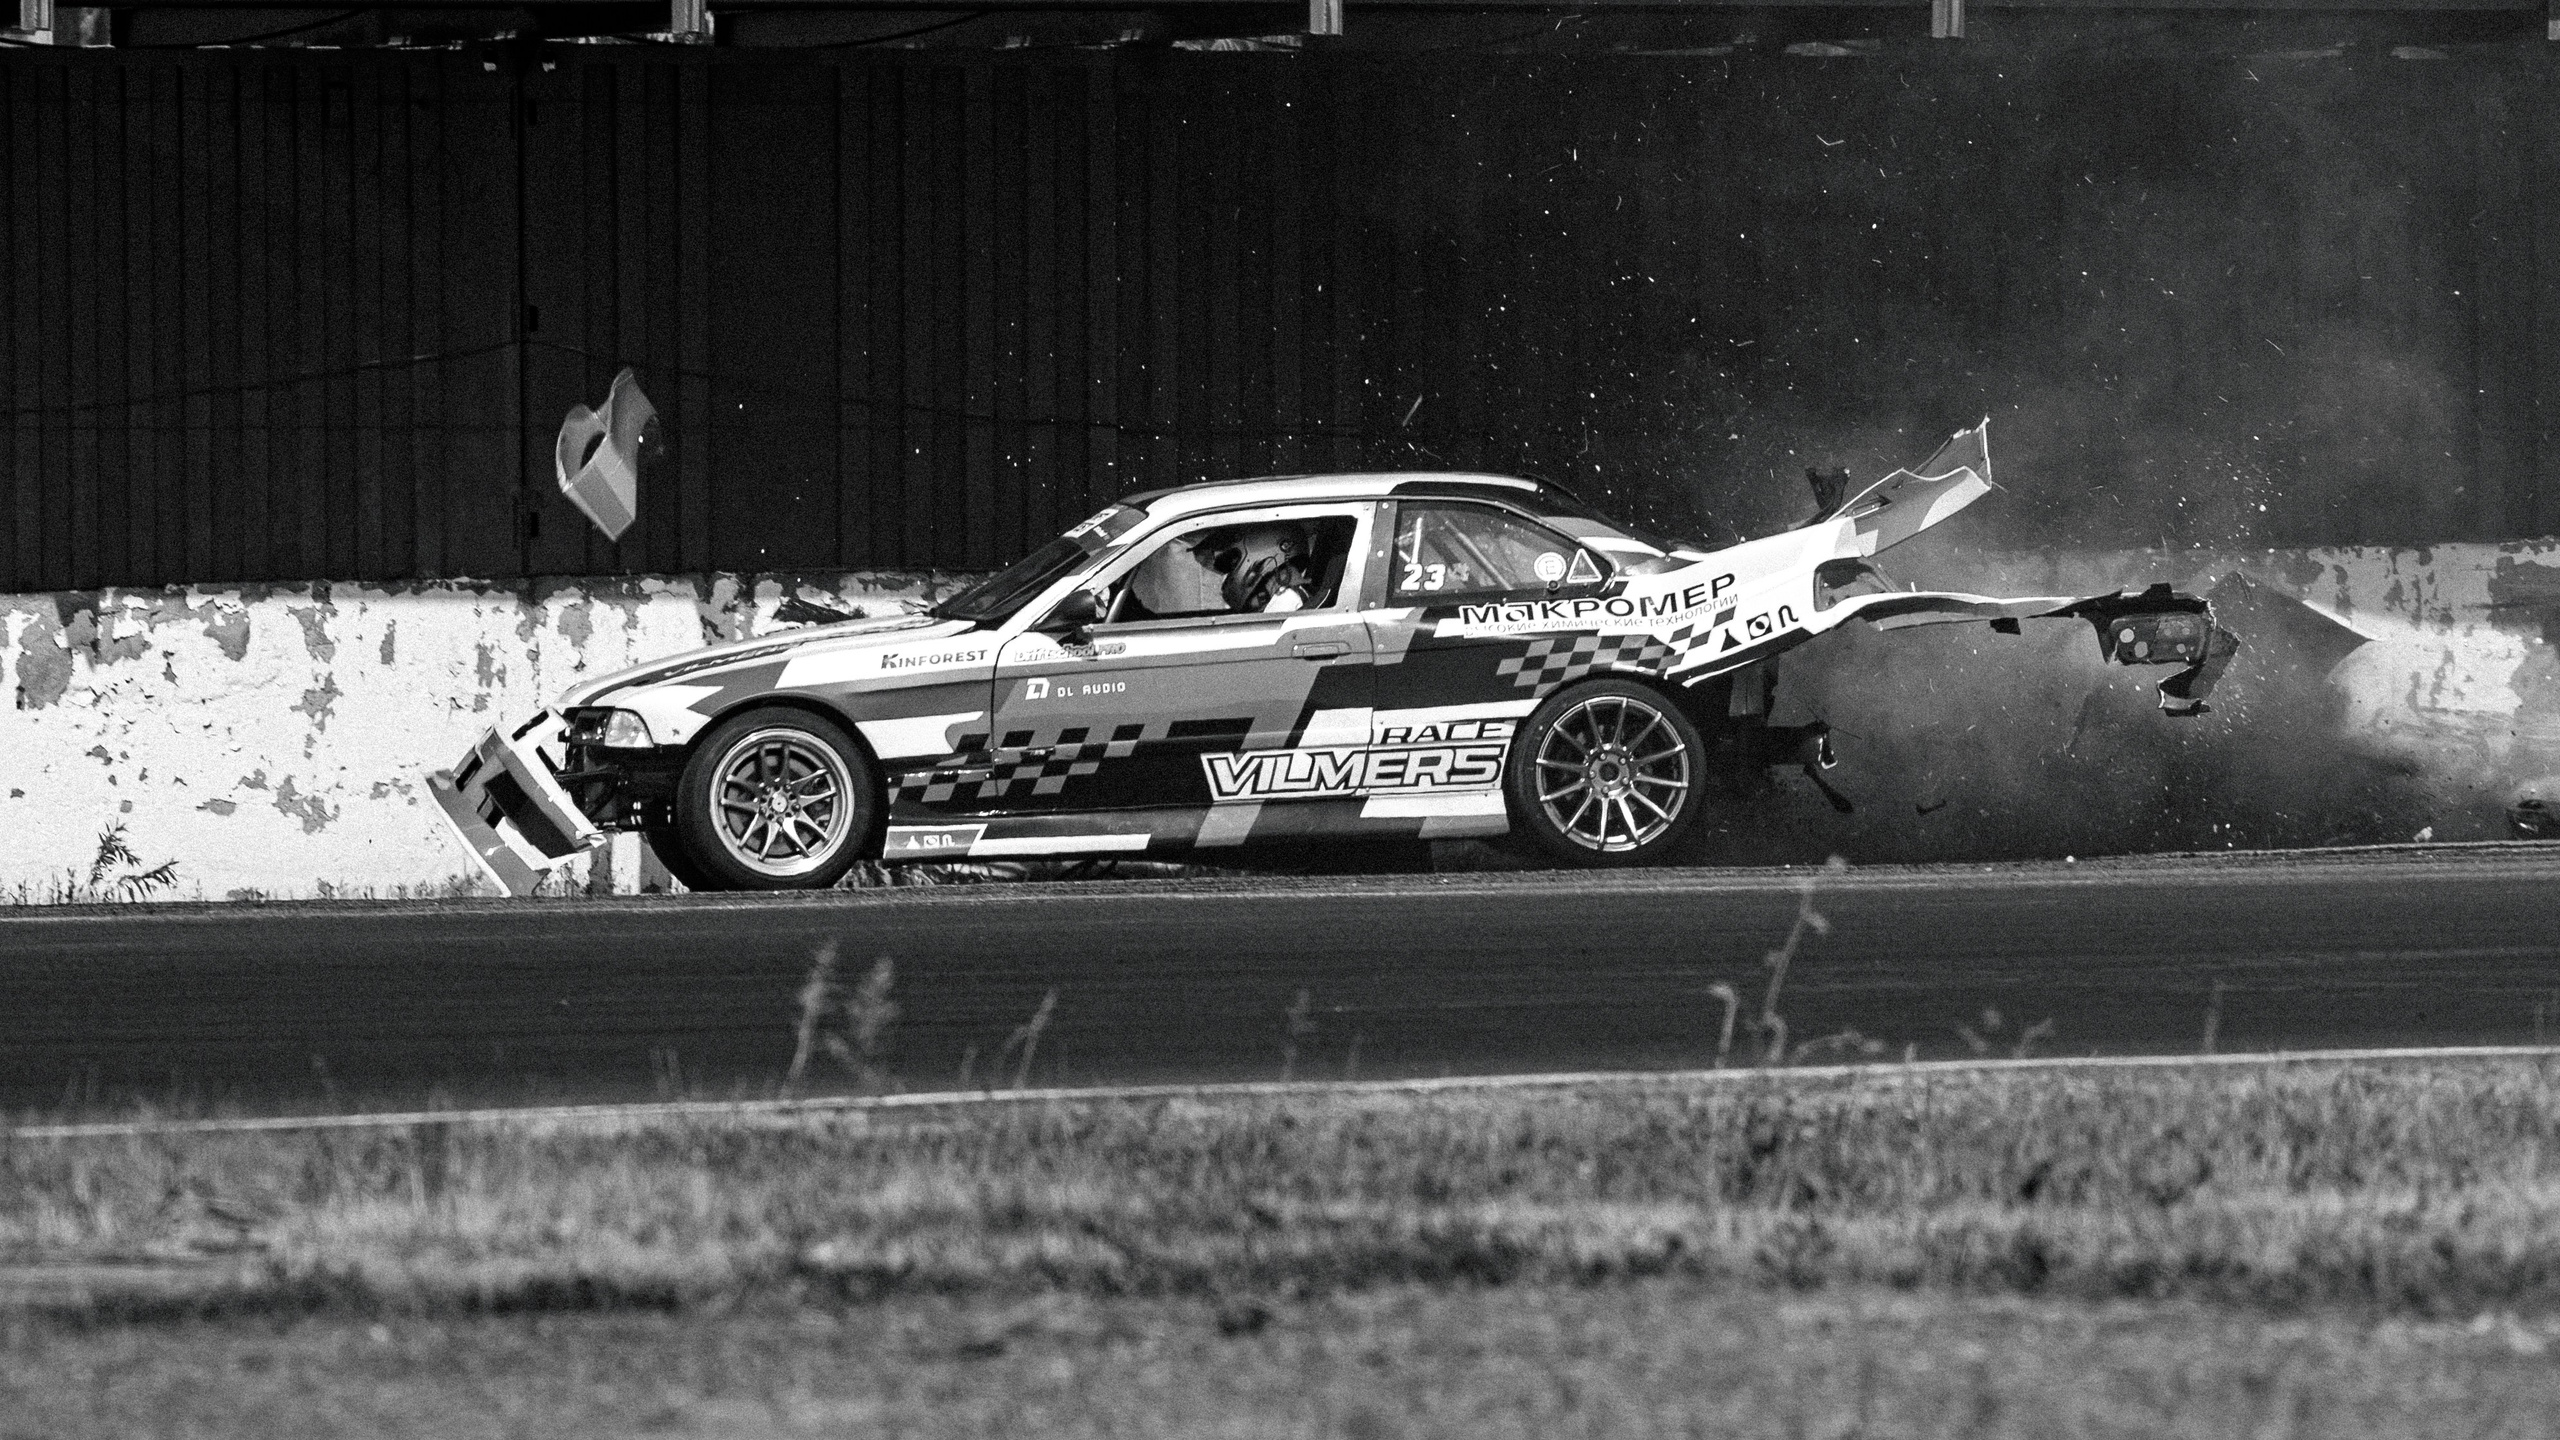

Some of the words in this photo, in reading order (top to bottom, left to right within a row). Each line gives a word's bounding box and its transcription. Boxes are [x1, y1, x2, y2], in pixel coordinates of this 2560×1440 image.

[1400, 563, 1446, 591] 23
[880, 649, 988, 669] KINFOREST
[1057, 686, 1074, 698] DL
[1082, 681, 1126, 695] AUDIO
[1380, 721, 1507, 745] RACE
[1208, 746, 1502, 797] VILMERS
